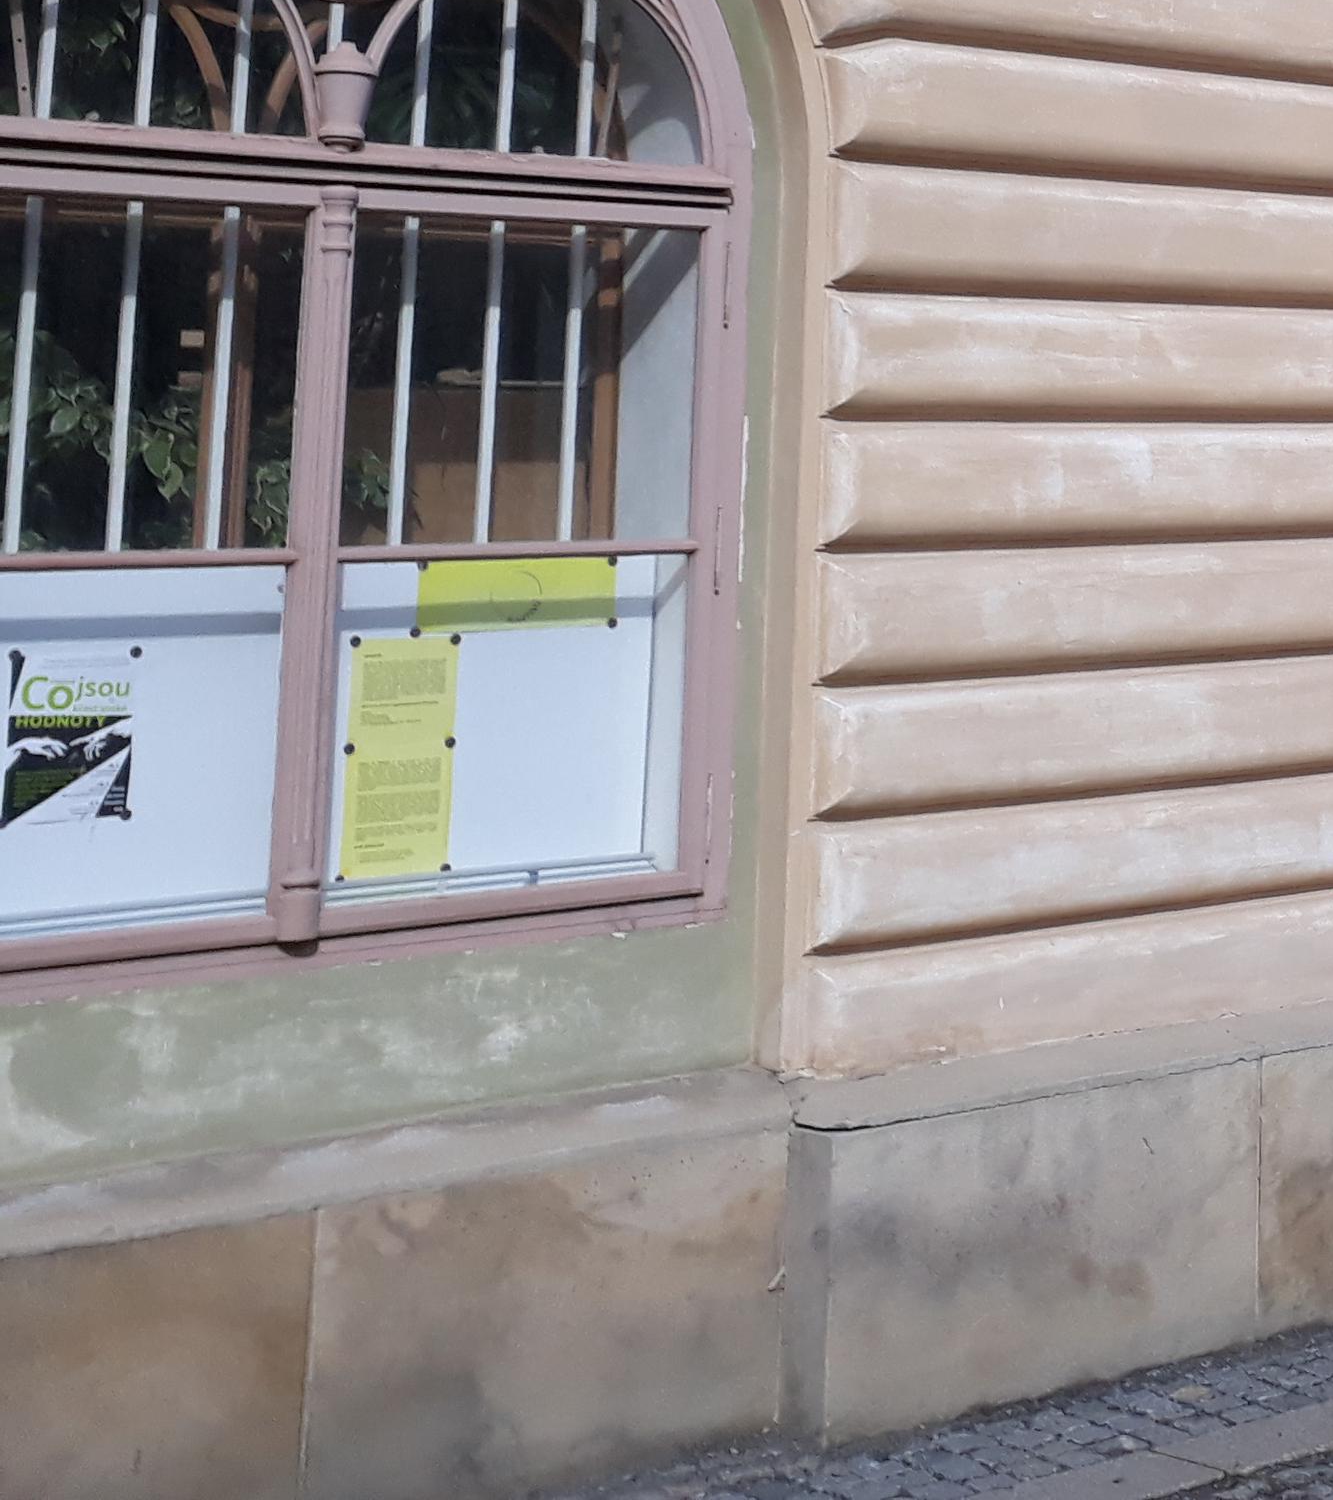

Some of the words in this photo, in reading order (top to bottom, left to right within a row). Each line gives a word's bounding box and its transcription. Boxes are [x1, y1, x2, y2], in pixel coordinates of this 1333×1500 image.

[22, 676, 74, 711] Co
[75, 676, 130, 702] jsou
[15, 715, 107, 729] HODNOTY
